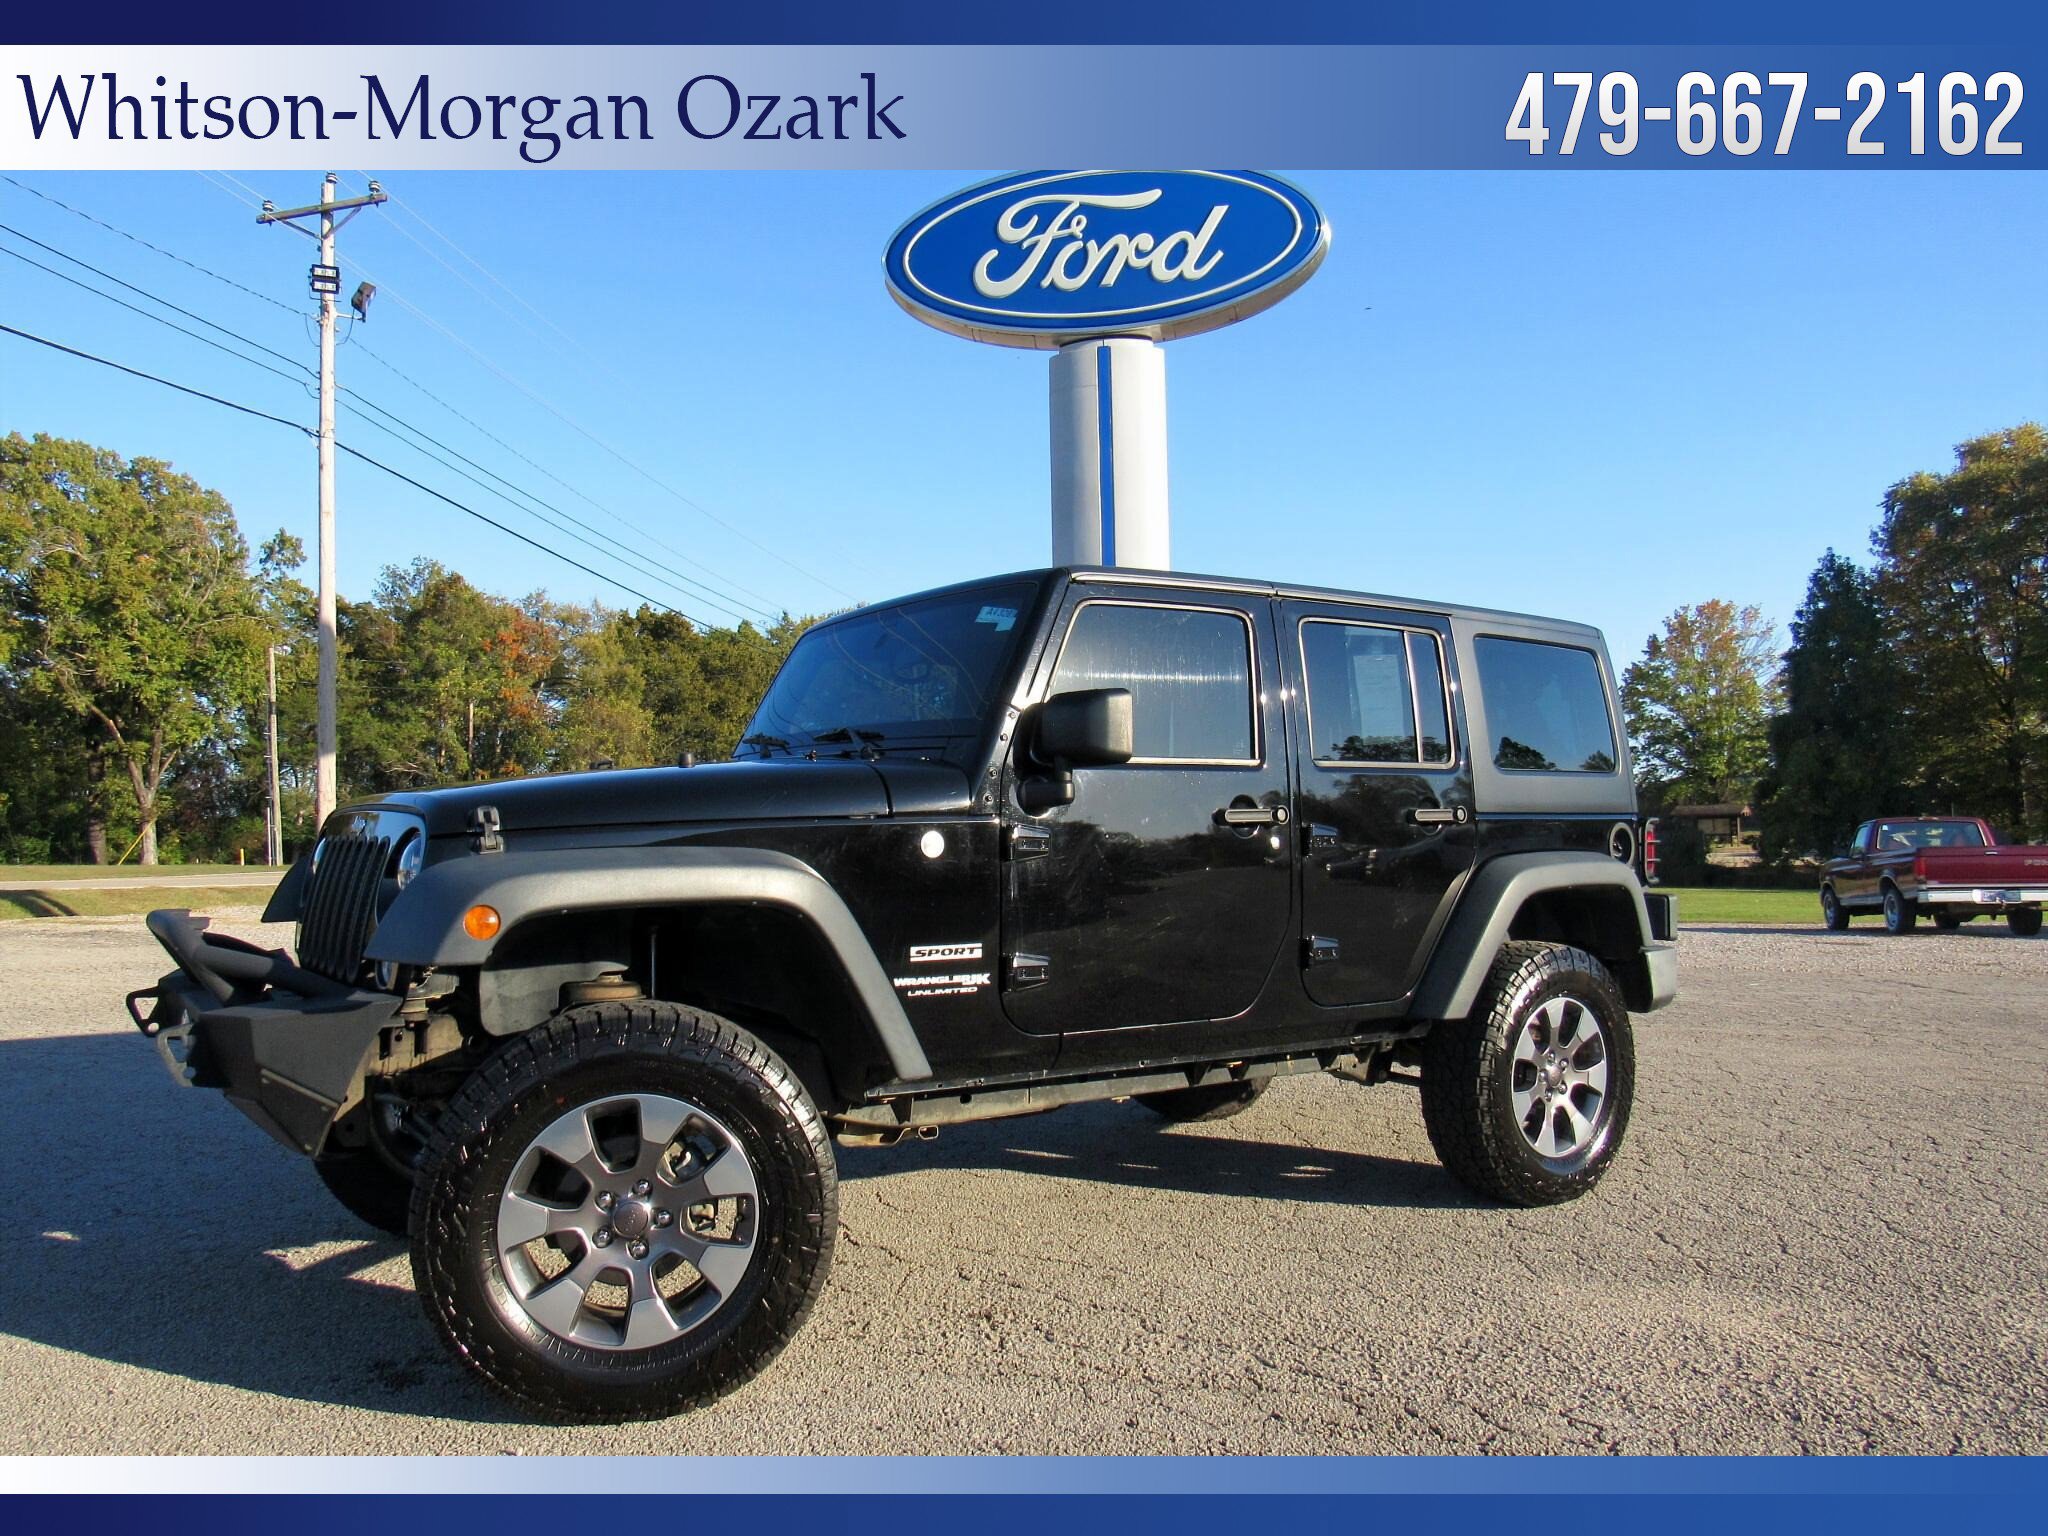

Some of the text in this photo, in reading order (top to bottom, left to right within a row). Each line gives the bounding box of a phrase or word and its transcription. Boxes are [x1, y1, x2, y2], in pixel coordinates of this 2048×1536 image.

[972, 188, 1230, 298] Ford
[914, 946, 977, 958] SPORT
[907, 986, 978, 997] UNLIMITED
